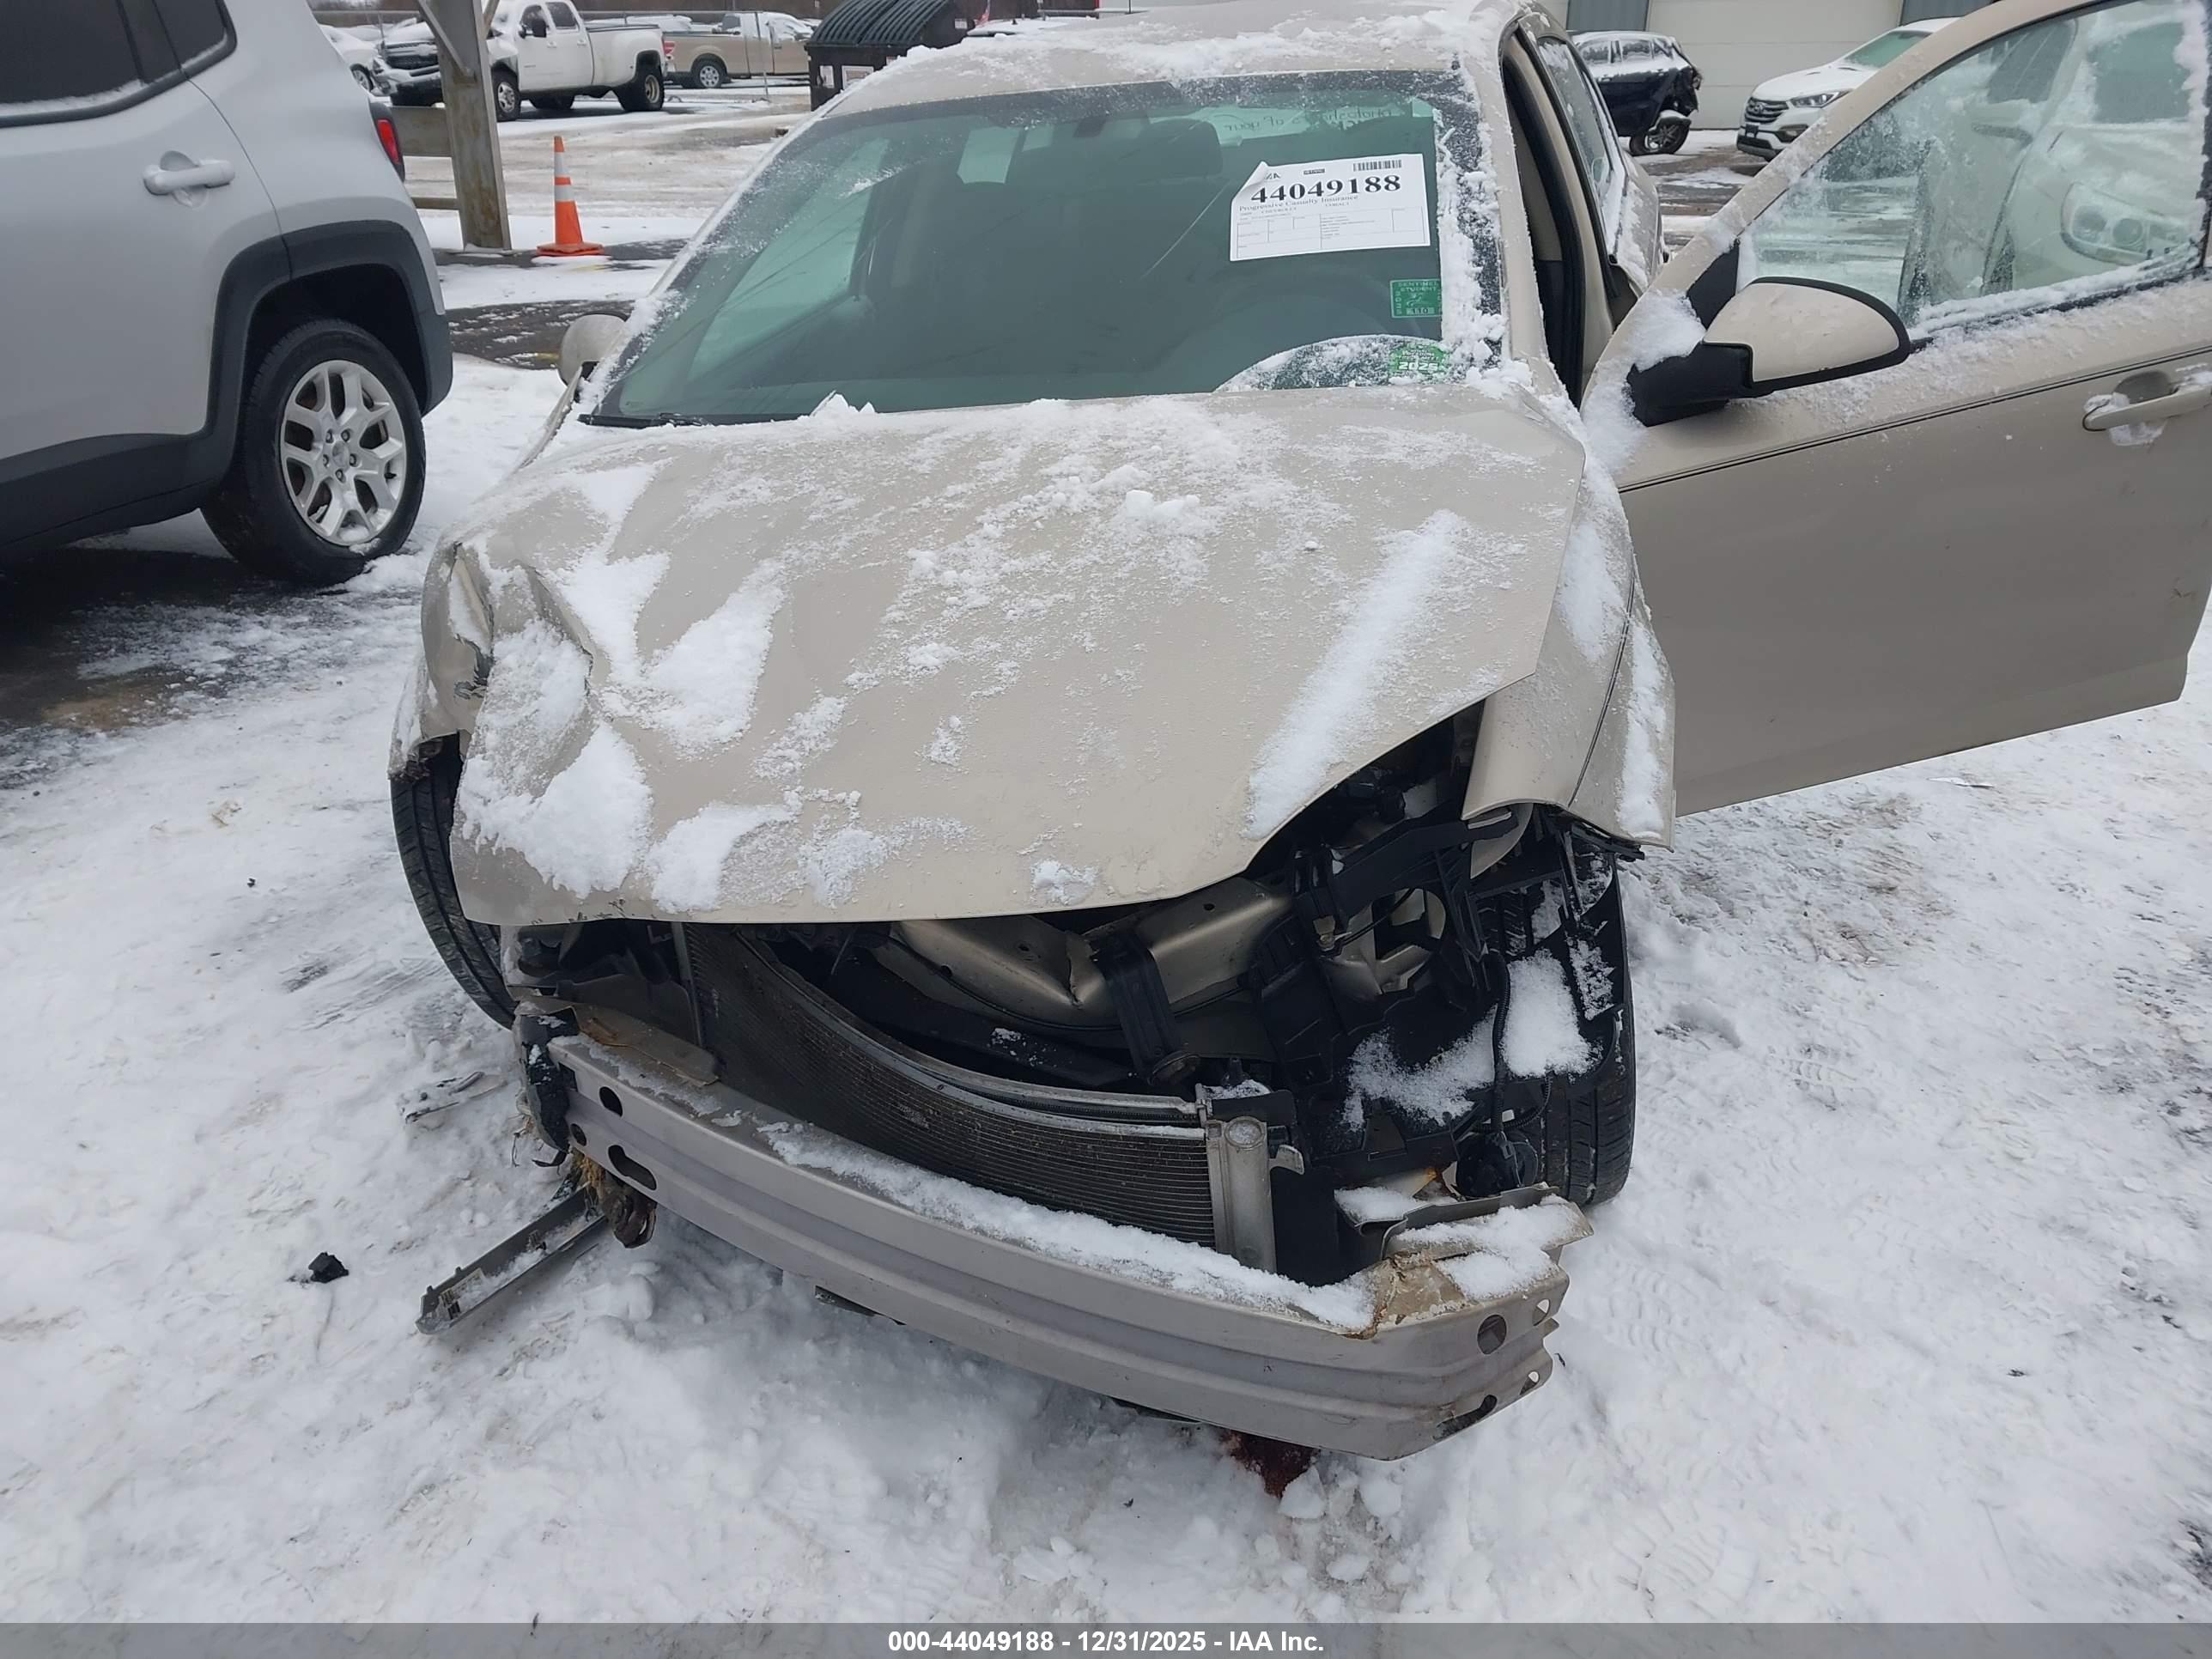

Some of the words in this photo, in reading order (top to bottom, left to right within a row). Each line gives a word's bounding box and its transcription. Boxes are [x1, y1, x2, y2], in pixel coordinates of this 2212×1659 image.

[1250, 174, 1401, 204] 44049188
[1238, 200, 1283, 212] Progressive
[1285, 197, 1317, 208] Casualty
[1321, 195, 1358, 205] Insurance
